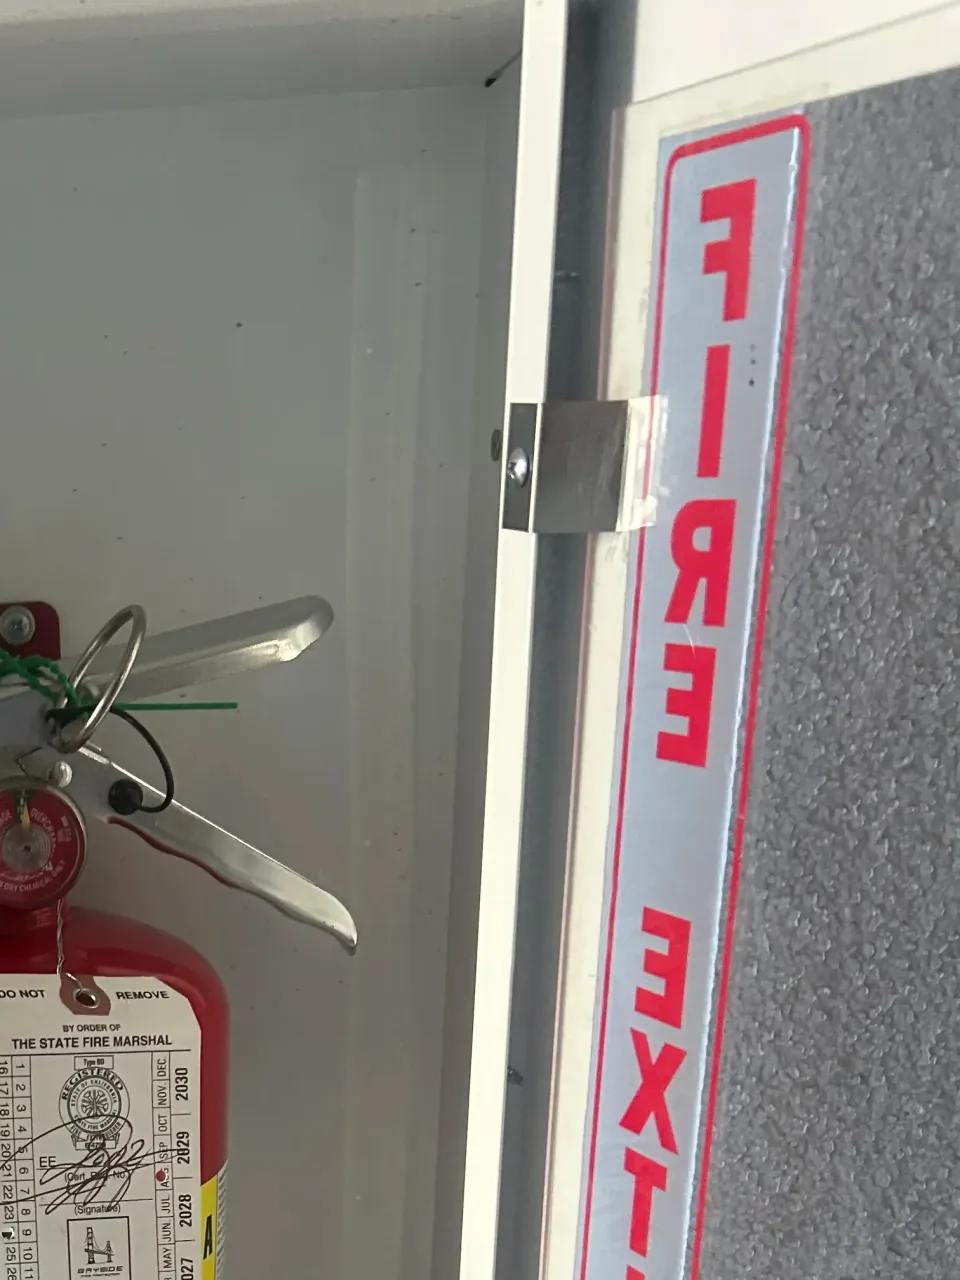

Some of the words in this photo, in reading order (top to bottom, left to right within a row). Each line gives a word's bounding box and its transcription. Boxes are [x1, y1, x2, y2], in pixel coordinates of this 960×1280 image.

[19, 989, 46, 998] NOT
[115, 990, 170, 1000] REMOVE
[62, 1024, 74, 1033] BY
[76, 1024, 108, 1032] ORDER
[109, 1023, 122, 1032] OF
[11, 1038, 36, 1050] THE
[39, 1037, 80, 1049] STATE
[82, 1036, 110, 1047] FIRE
[113, 1034, 173, 1047] MARSHAL
[0, 1081, 9, 1096] 17
[16, 1083, 26, 1092] 2
[61, 1068, 124, 1101] REGISTERED
[175, 1067, 189, 1101] 2030
[0, 1103, 10, 1117] 18
[16, 1104, 27, 1113] 3
[0, 1123, 11, 1138] 19
[17, 1125, 27, 1133] 4
[1, 1143, 11, 1158] 20
[176, 1131, 190, 1165] 2029
[39, 1156, 56, 1168] EE
[2, 1164, 13, 1178] 21
[18, 1166, 29, 1175] 6
[3, 1184, 13, 1200] 22
[20, 1187, 30, 1195] 7
[4, 1205, 15, 1220] 23
[21, 1208, 32, 1216] 8
[178, 1194, 193, 1228] 2028
[21, 1228, 32, 1237] 9
[202, 1214, 213, 1261] A
[5, 1246, 16, 1262] 25
[23, 1247, 33, 1261] 10
[163, 1247, 172, 1269] MAY
[24, 1268, 34, 1279] 11
